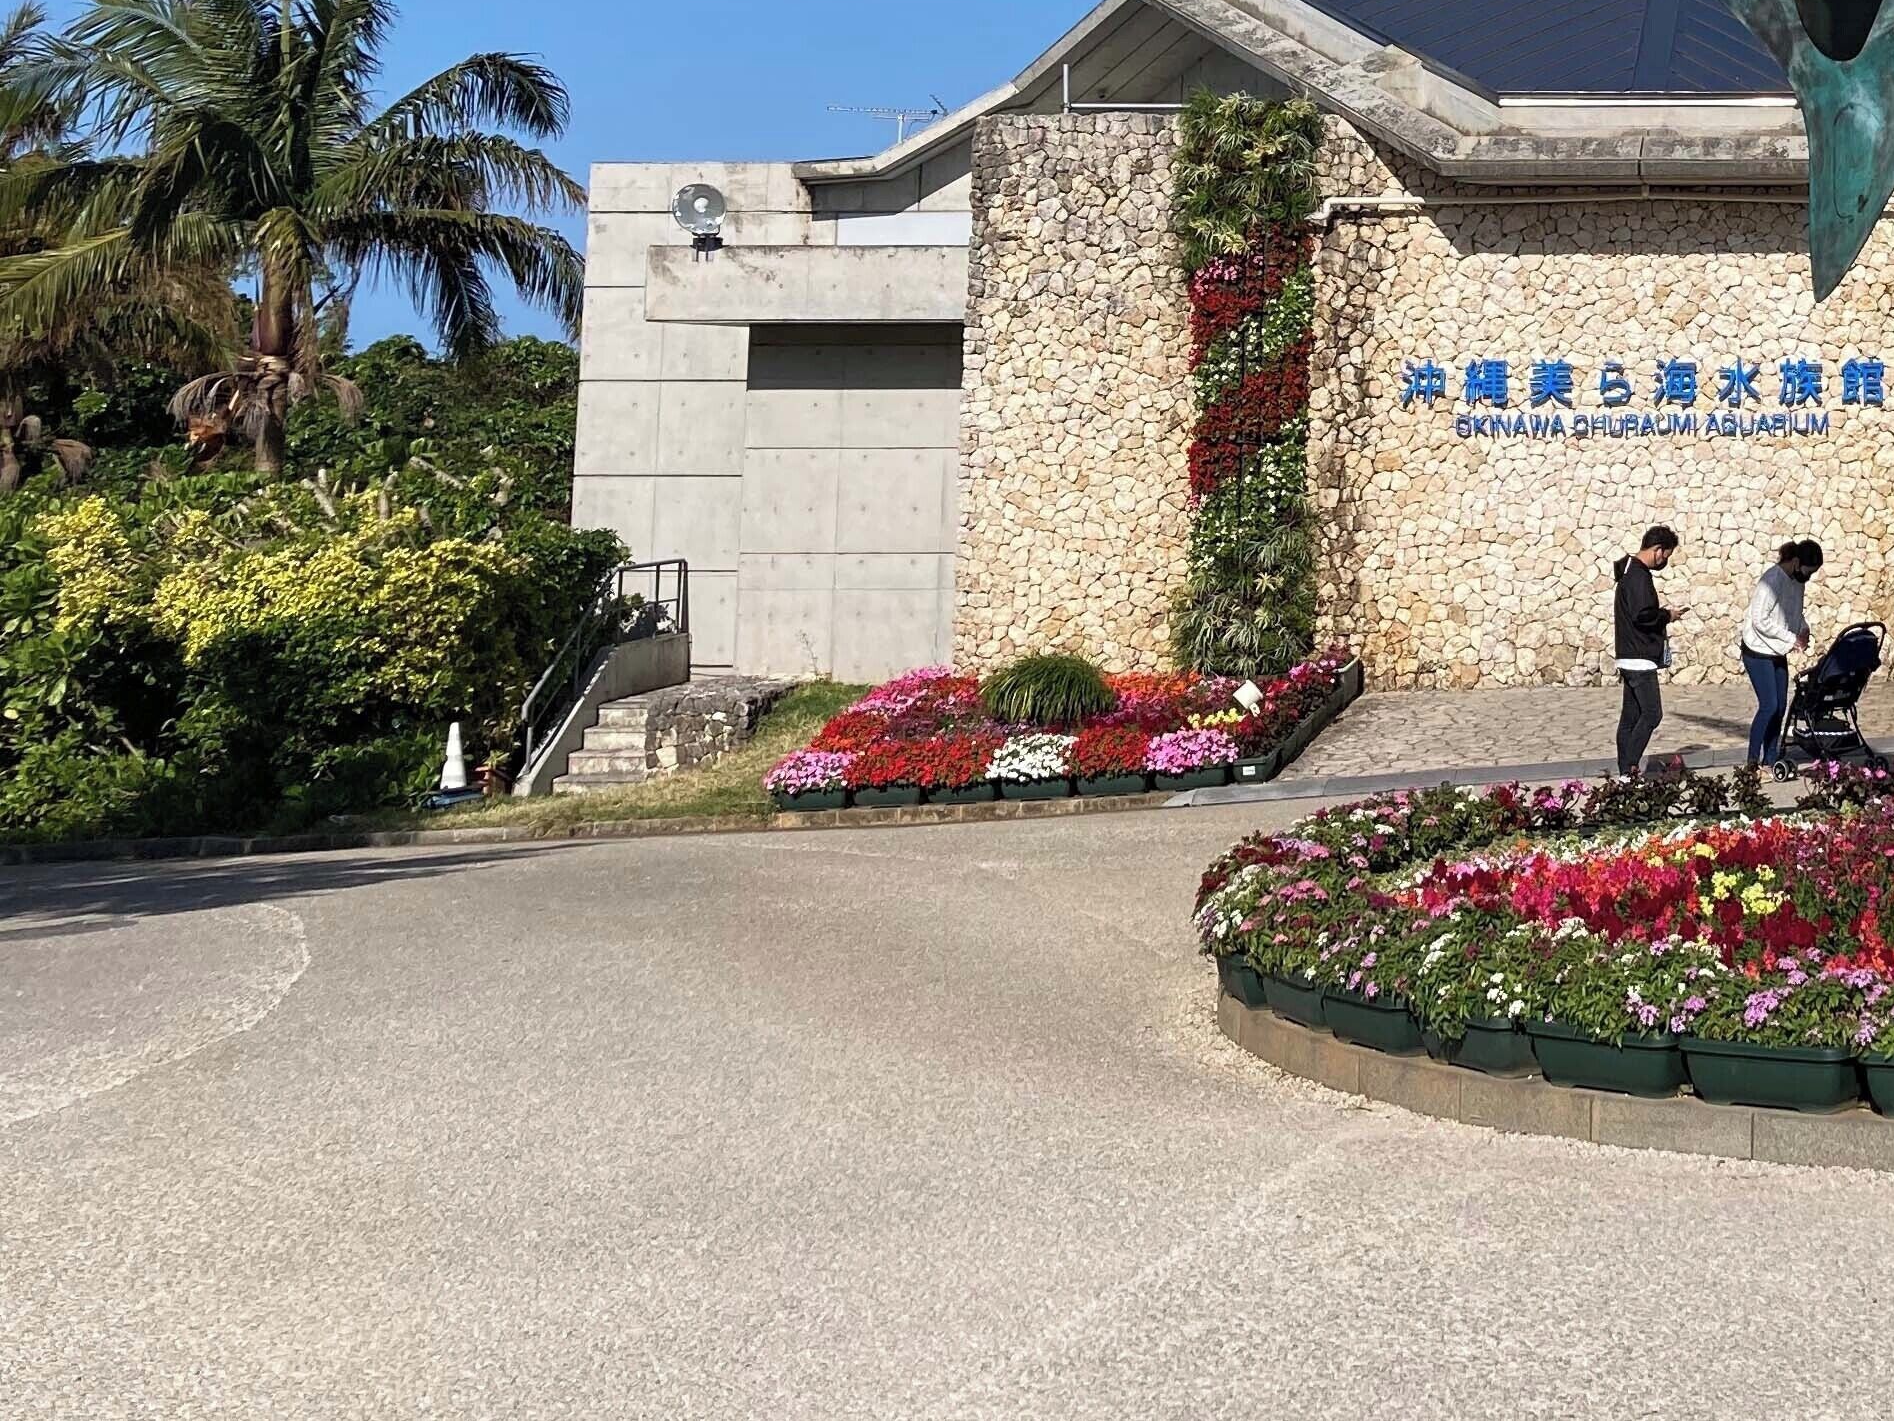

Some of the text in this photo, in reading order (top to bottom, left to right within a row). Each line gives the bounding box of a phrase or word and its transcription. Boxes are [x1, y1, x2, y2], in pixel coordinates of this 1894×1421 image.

[1400, 357, 1885, 409] 沖縄美ら海水族館
[1455, 412, 1829, 438] OKINAWA CHURAUMI AQUARIUM
